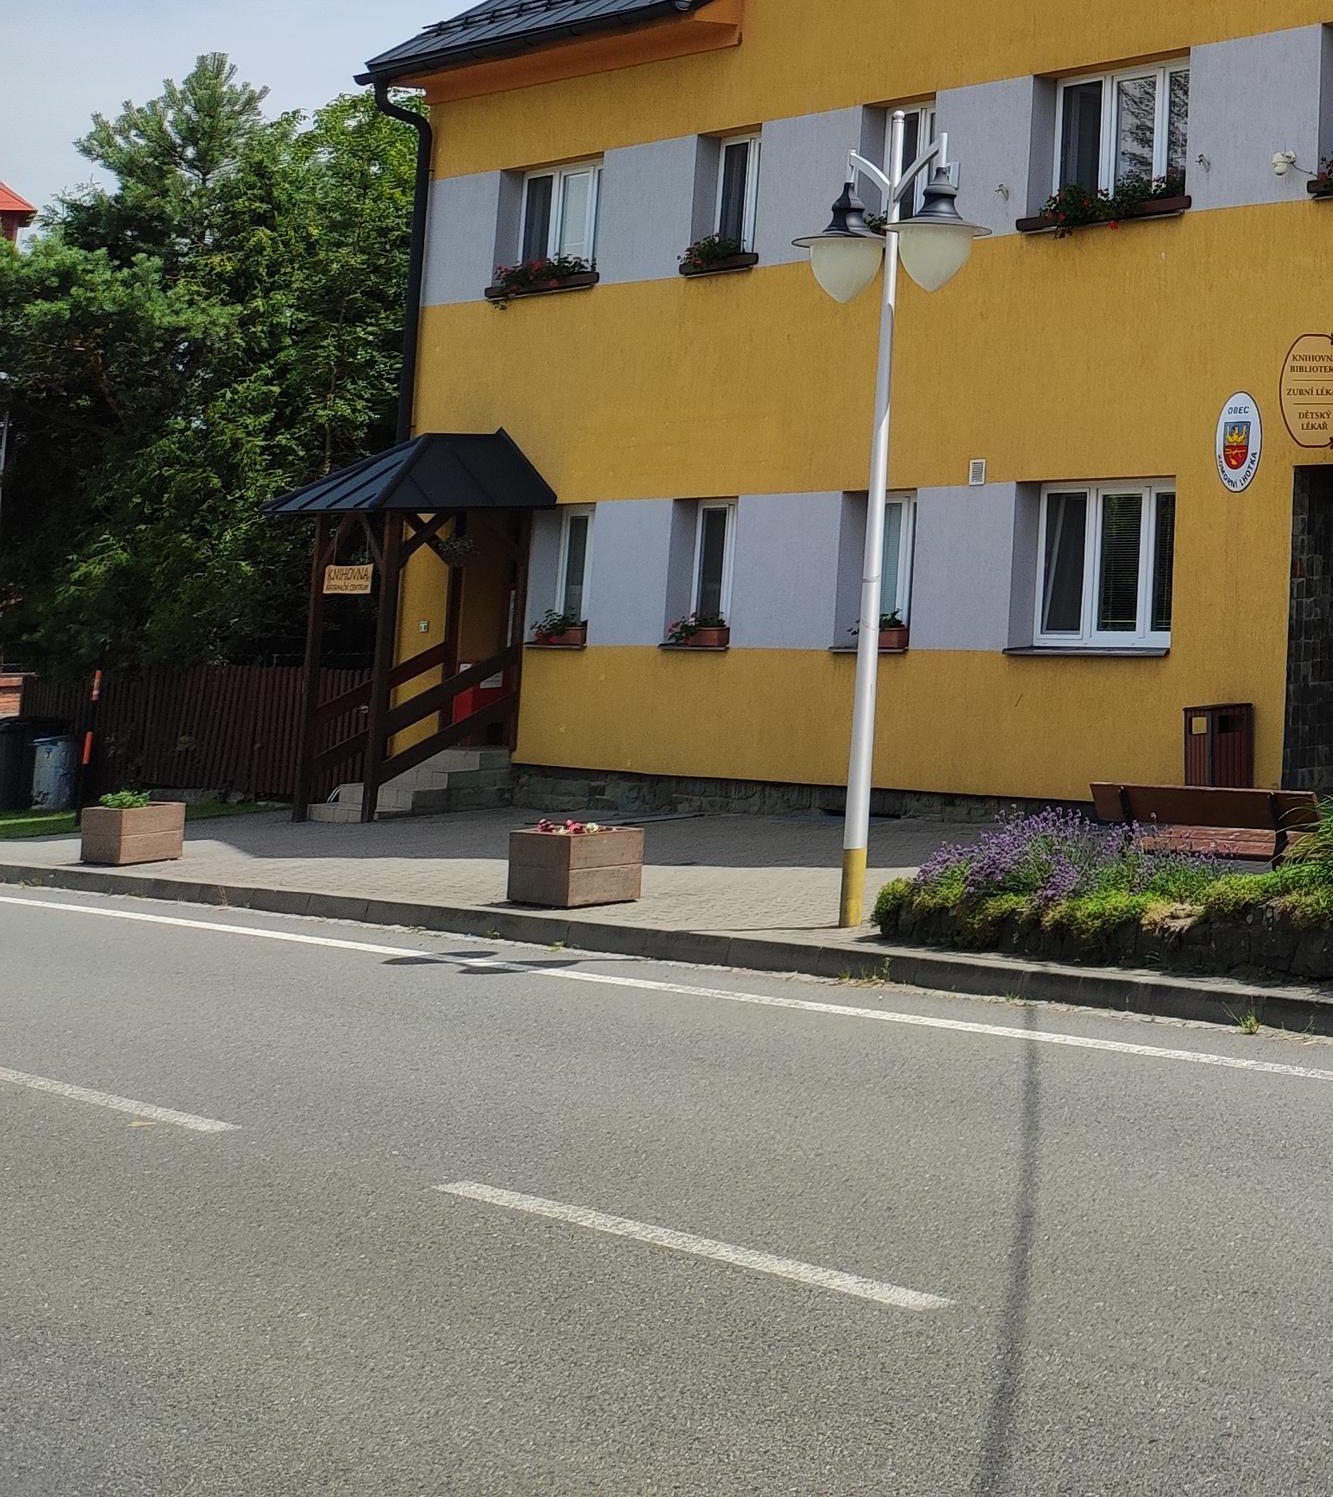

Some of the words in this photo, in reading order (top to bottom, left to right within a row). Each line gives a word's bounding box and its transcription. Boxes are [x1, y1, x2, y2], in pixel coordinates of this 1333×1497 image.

[1286, 386, 1314, 396] ZUBNÍ
[1227, 406, 1250, 414] OBEC
[1298, 409, 1332, 419] DĚTSKÝ
[1301, 422, 1328, 430] LÉKAŘ
[1239, 452, 1258, 486] LHOTKA
[327, 567, 369, 580] KNIHOVNA
